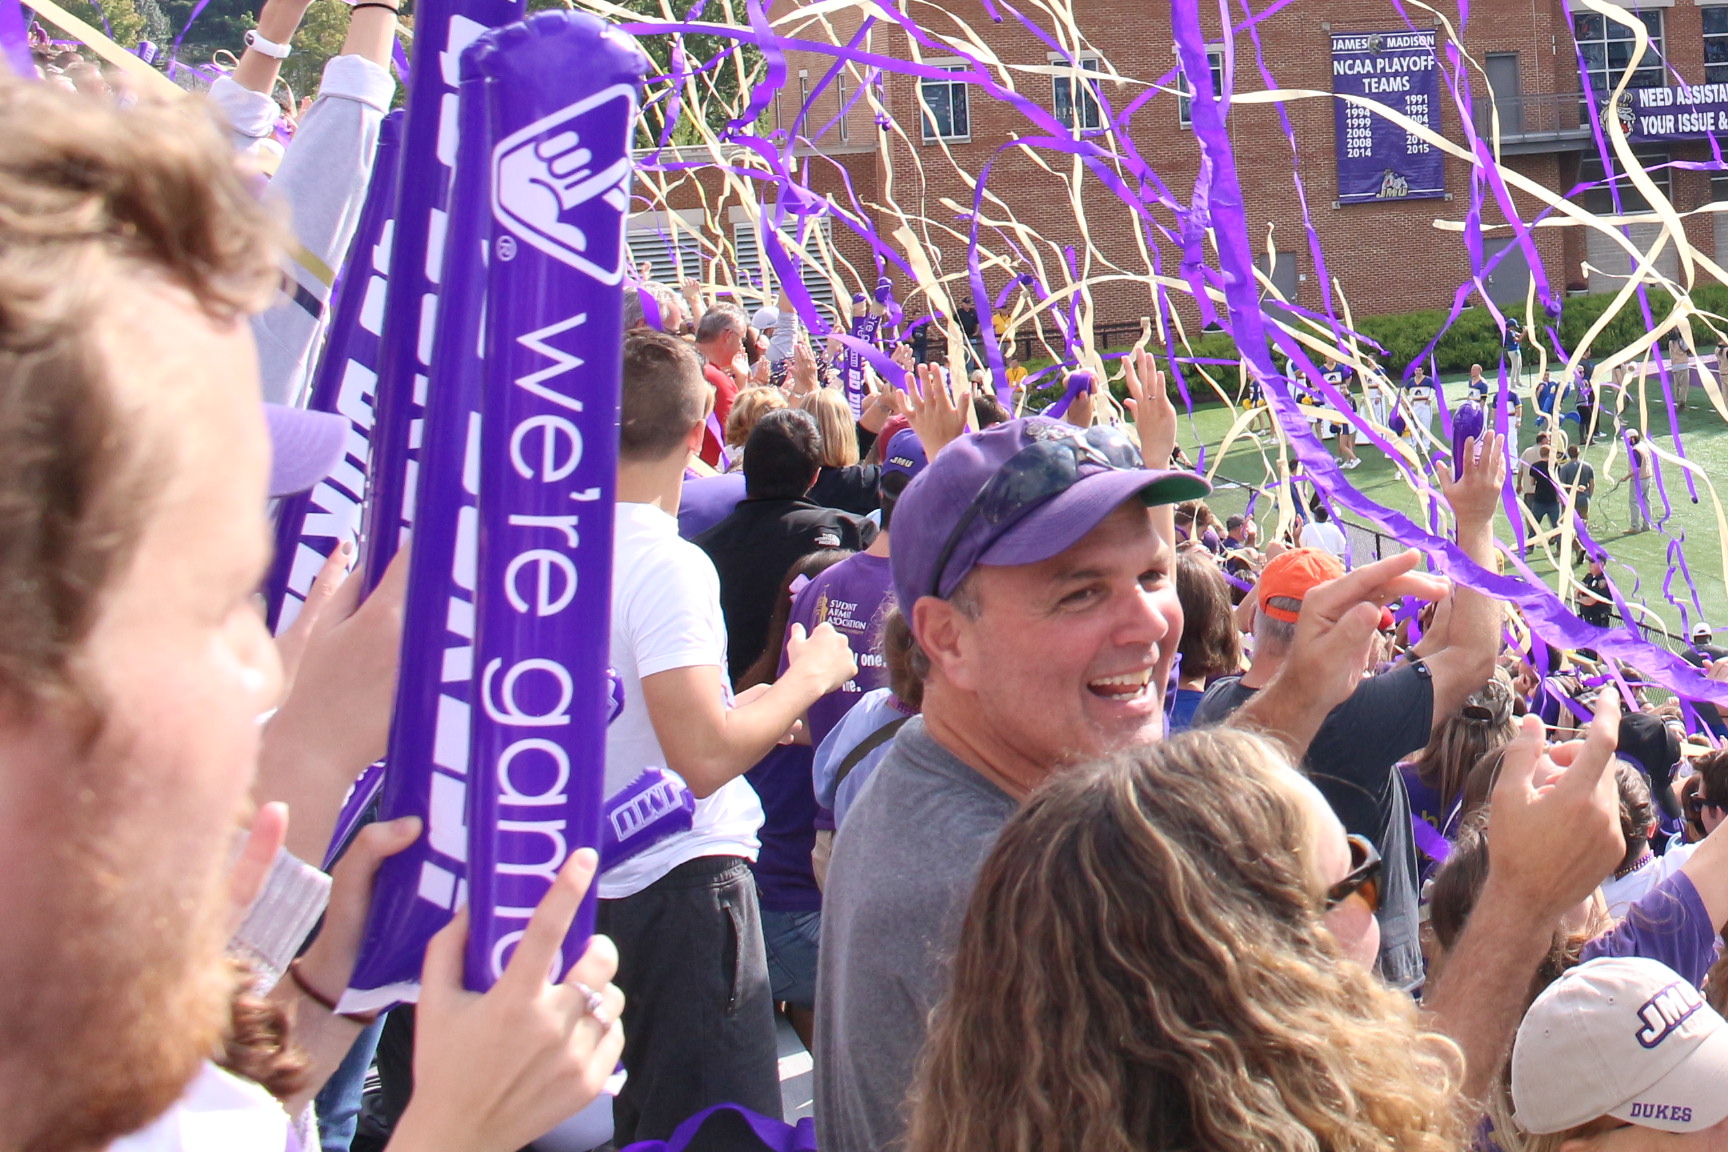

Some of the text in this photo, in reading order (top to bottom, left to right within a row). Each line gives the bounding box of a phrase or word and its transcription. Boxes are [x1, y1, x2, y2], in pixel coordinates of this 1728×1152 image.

[1332, 35, 1435, 51] JAMES MADISON
[1333, 55, 1435, 75] NCAA PLAYOFF
[1362, 76, 1410, 93] TEAMS
[1405, 94, 1428, 104] 1991
[1638, 87, 1673, 108] NEED
[1345, 108, 1371, 118] 1994
[1405, 104, 1428, 114] 1995
[1346, 118, 1371, 128] 1999
[1640, 113, 1676, 135] YOUR
[1678, 111, 1715, 133] ISSUE
[1717, 110, 1728, 131] &
[1346, 128, 1372, 138] 2006
[1347, 138, 1372, 148] 2008
[1406, 144, 1430, 154] 2015
[1347, 148, 1372, 158] 2014
[506, 311, 604, 618] we're
[889, 456, 914, 468] JMU
[861, 653, 887, 667] one.
[1630, 1102, 1692, 1123] DUKES
